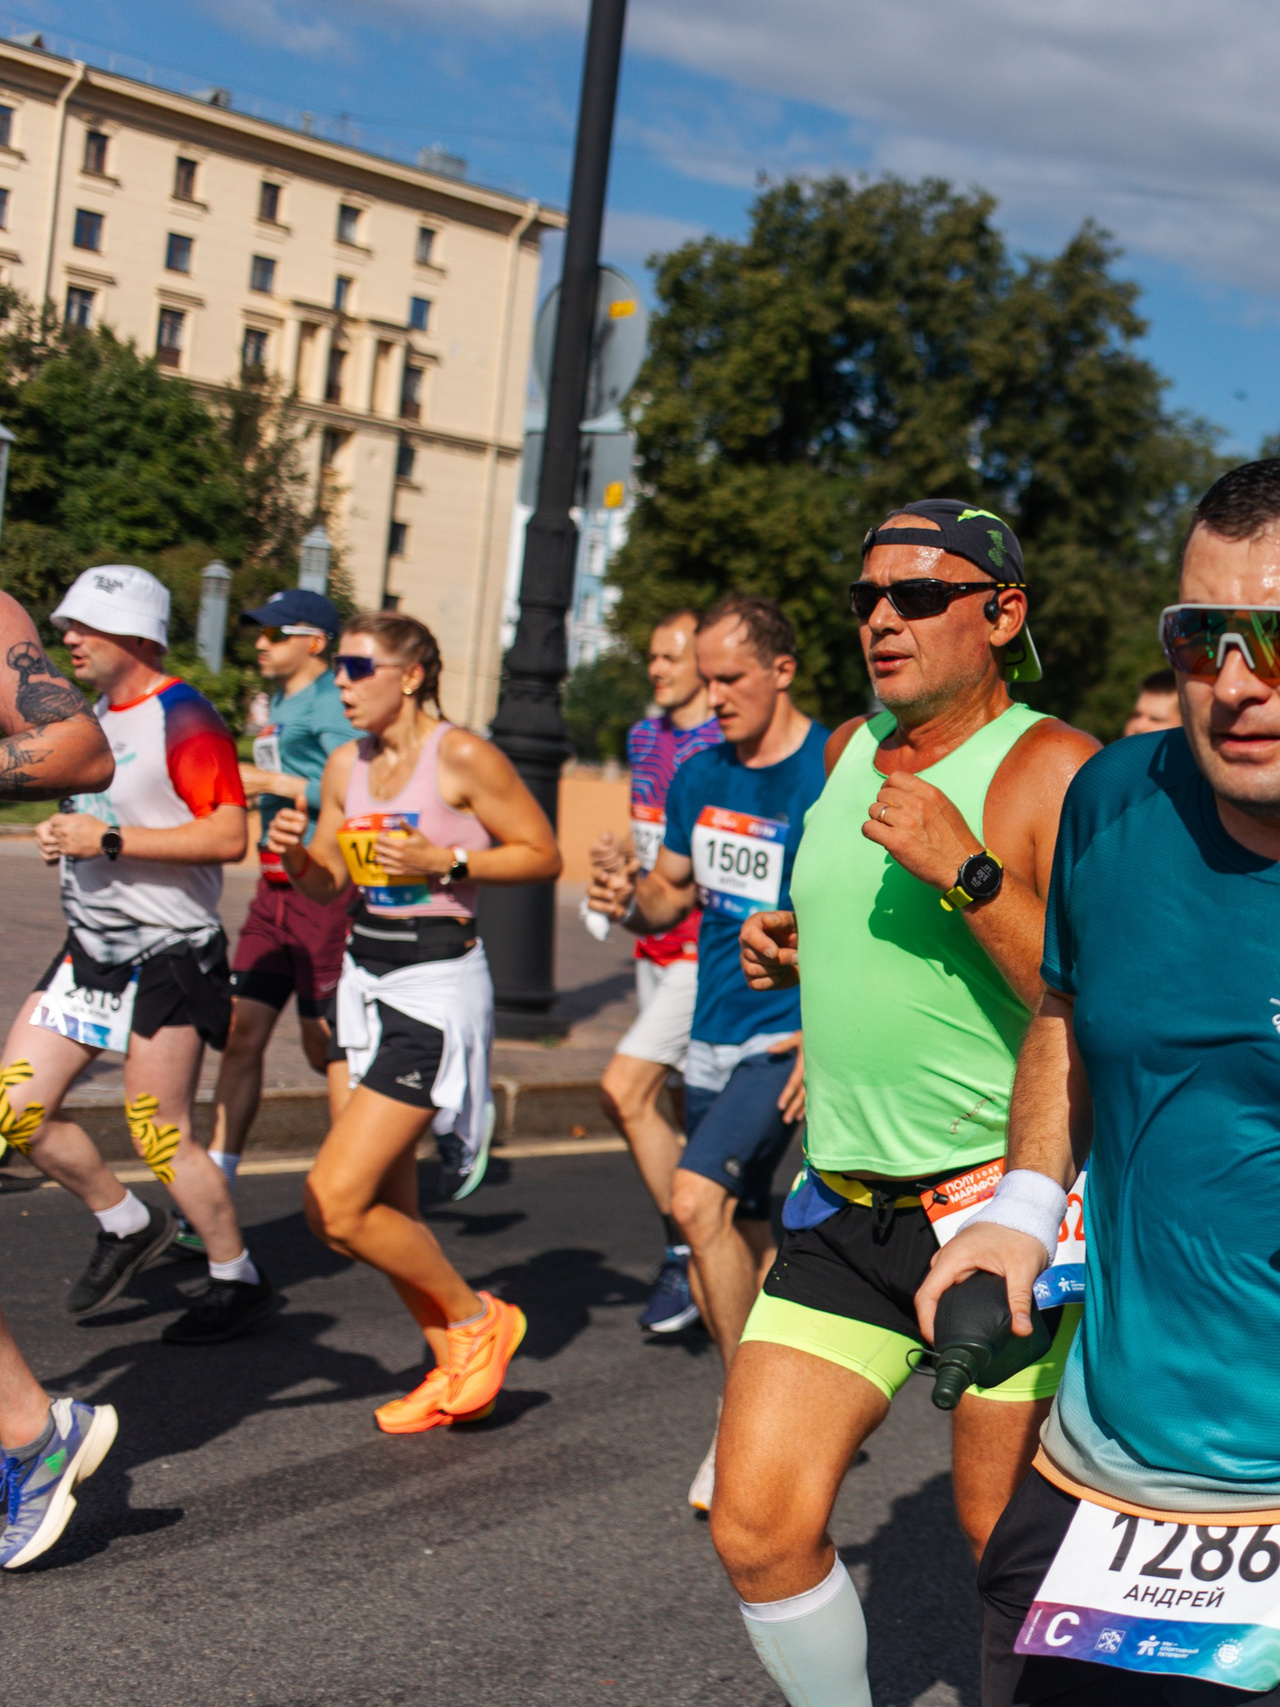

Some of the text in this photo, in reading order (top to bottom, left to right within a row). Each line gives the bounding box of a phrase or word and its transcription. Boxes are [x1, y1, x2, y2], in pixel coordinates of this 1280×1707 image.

[707, 840, 768, 879] 1508
[945, 1173, 975, 1194] ПОЛУ
[949, 1172, 1003, 1203] МАРАФОН
[1123, 1584, 1225, 1608] АНДРЕЙ
[1045, 1611, 1080, 1646] C
